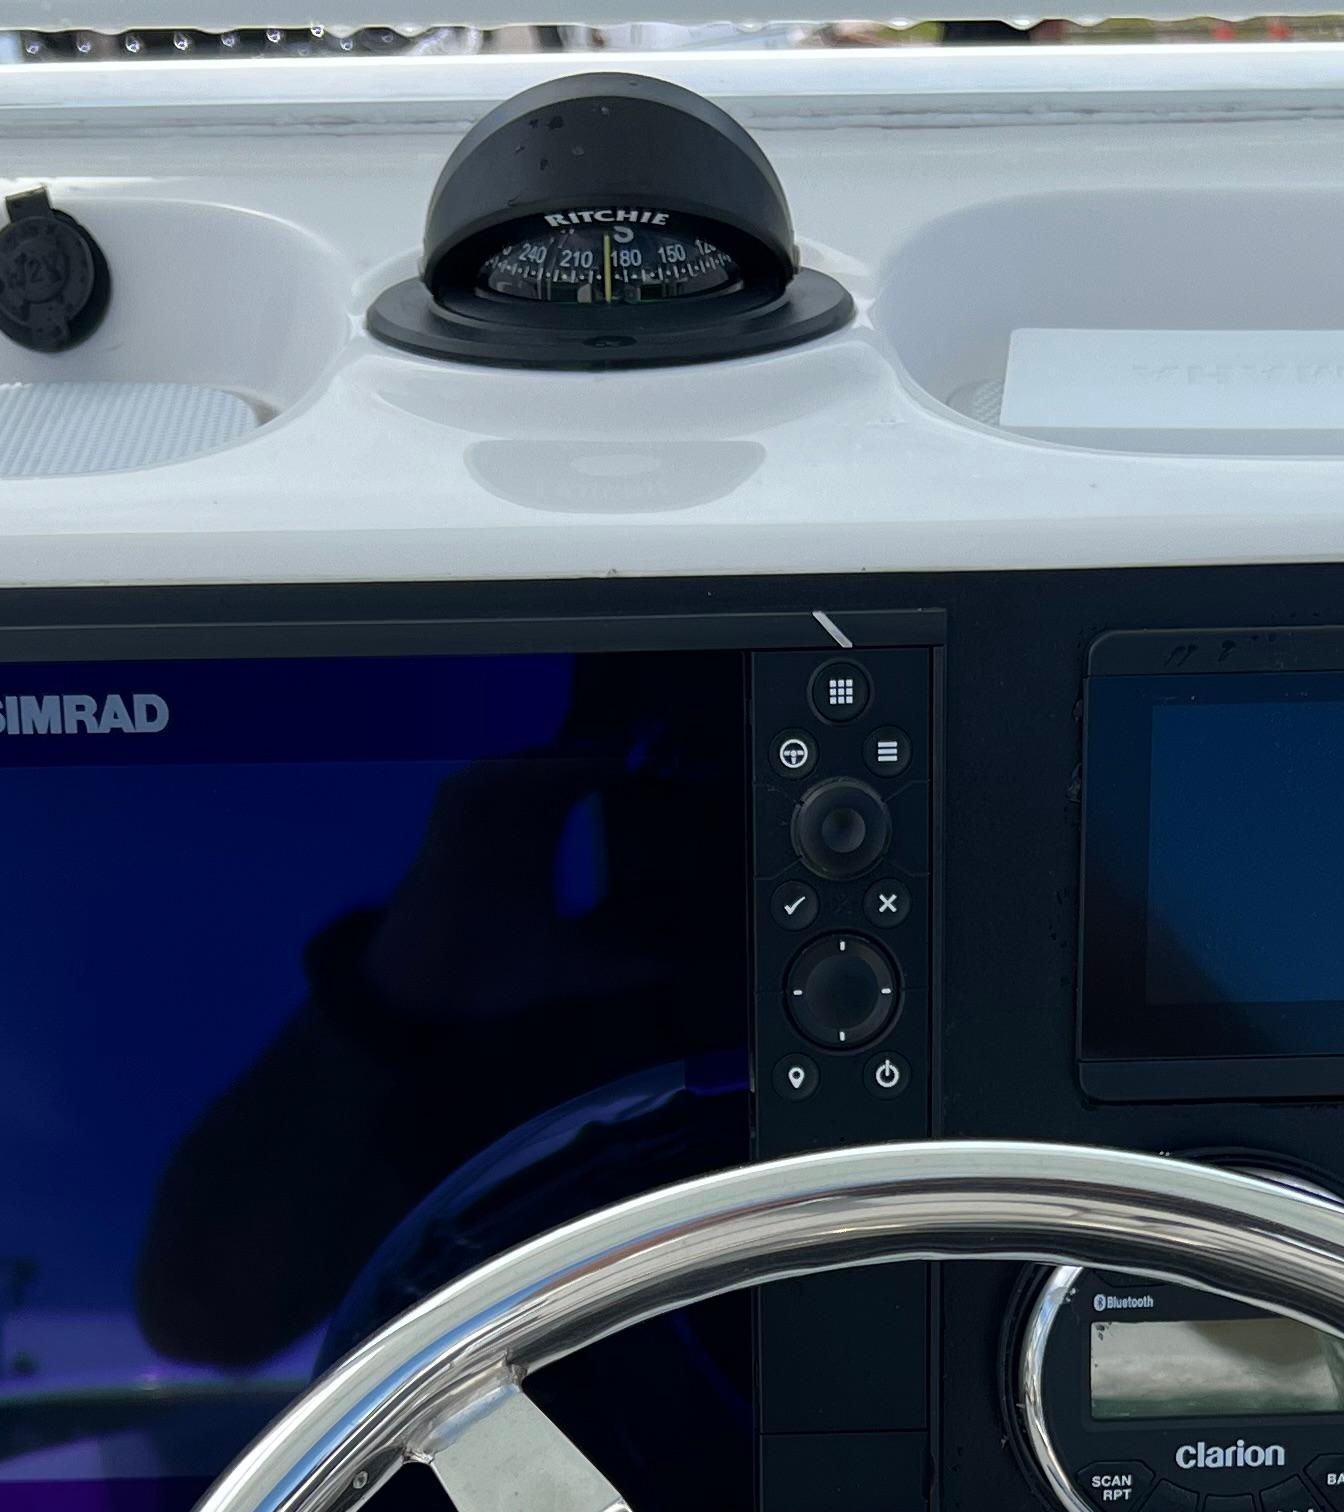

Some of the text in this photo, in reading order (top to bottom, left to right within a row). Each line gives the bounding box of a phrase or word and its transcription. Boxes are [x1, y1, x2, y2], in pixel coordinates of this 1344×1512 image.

[544, 210, 670, 227] RITCHIE
[519, 243, 547, 264] 240
[560, 250, 593, 268] 210
[611, 250, 641, 267] 180
[659, 244, 686, 263] 150
[1106, 1295, 1154, 1309] Bluetooth
[1175, 1439, 1285, 1469] clarion
[1091, 1474, 1132, 1488] SCAN
[1103, 1488, 1131, 1502] RPT
